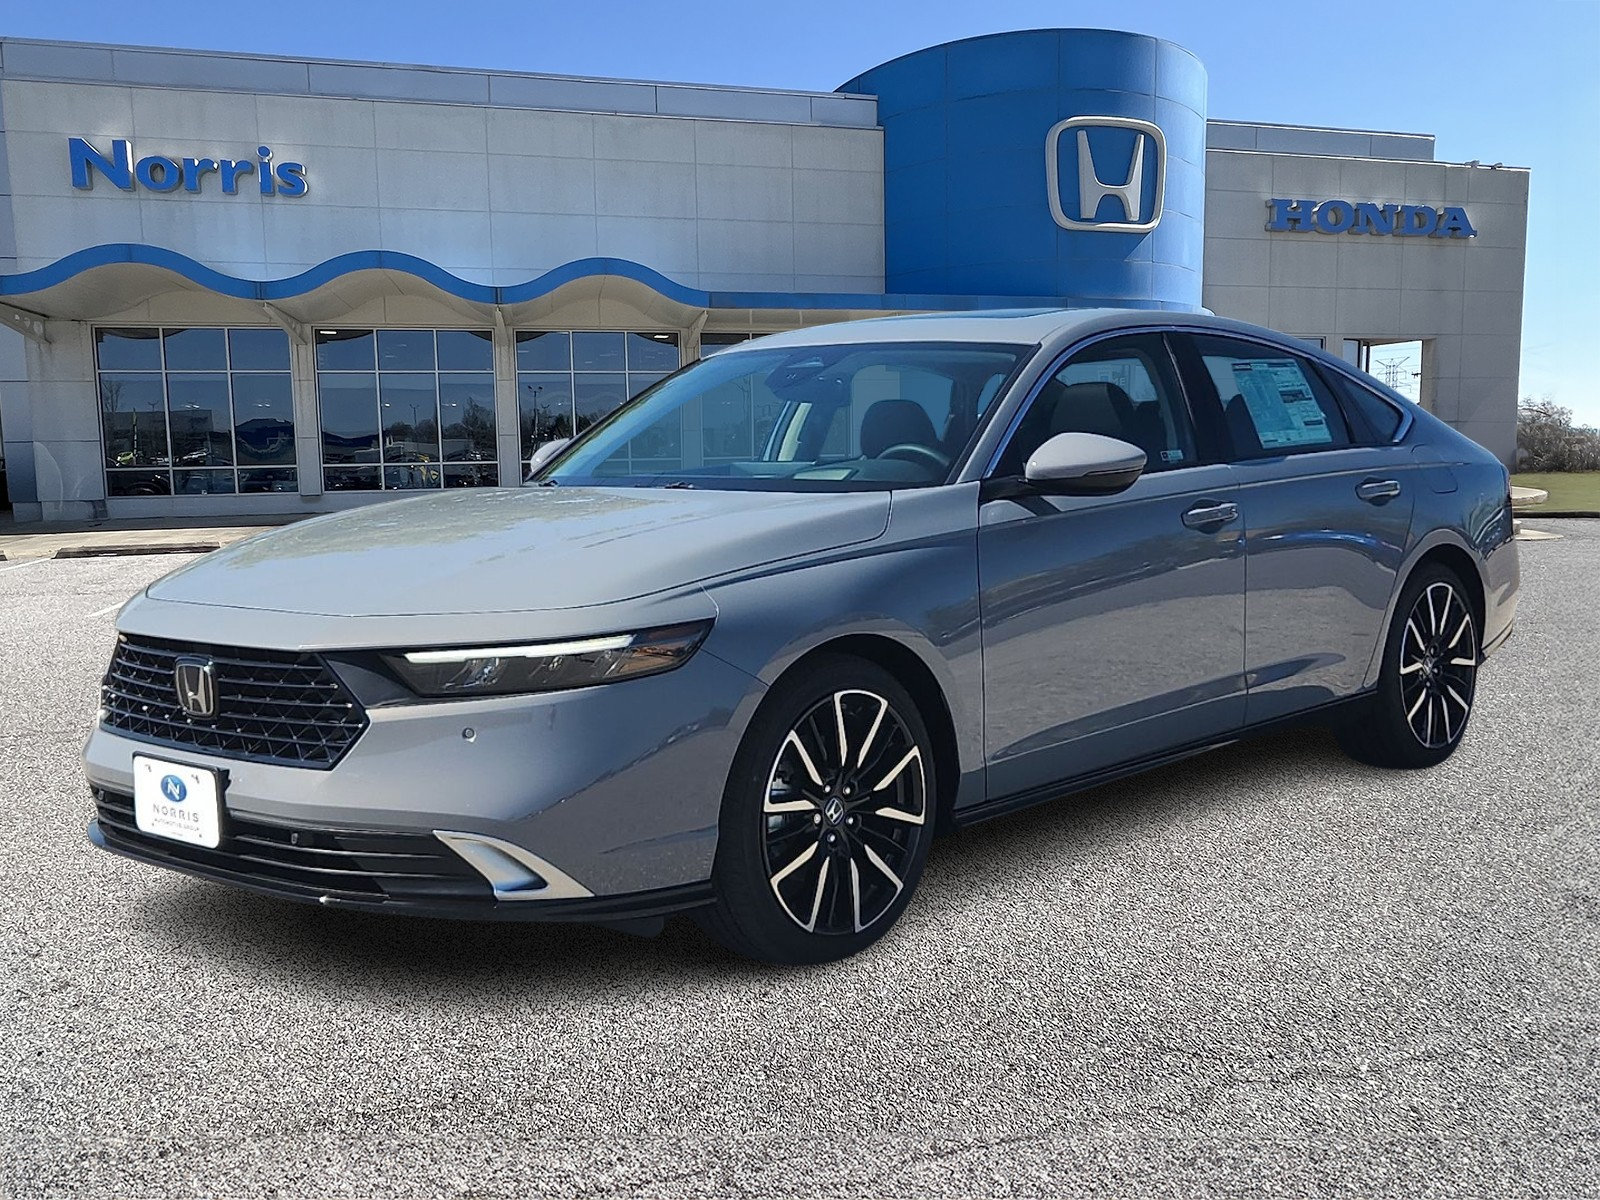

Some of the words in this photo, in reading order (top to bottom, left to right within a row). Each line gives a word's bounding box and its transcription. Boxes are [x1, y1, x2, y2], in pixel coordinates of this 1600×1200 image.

[68, 137, 308, 197] Norris
[1265, 198, 1477, 239] HONDA
[153, 803, 199, 822] NORRIS
